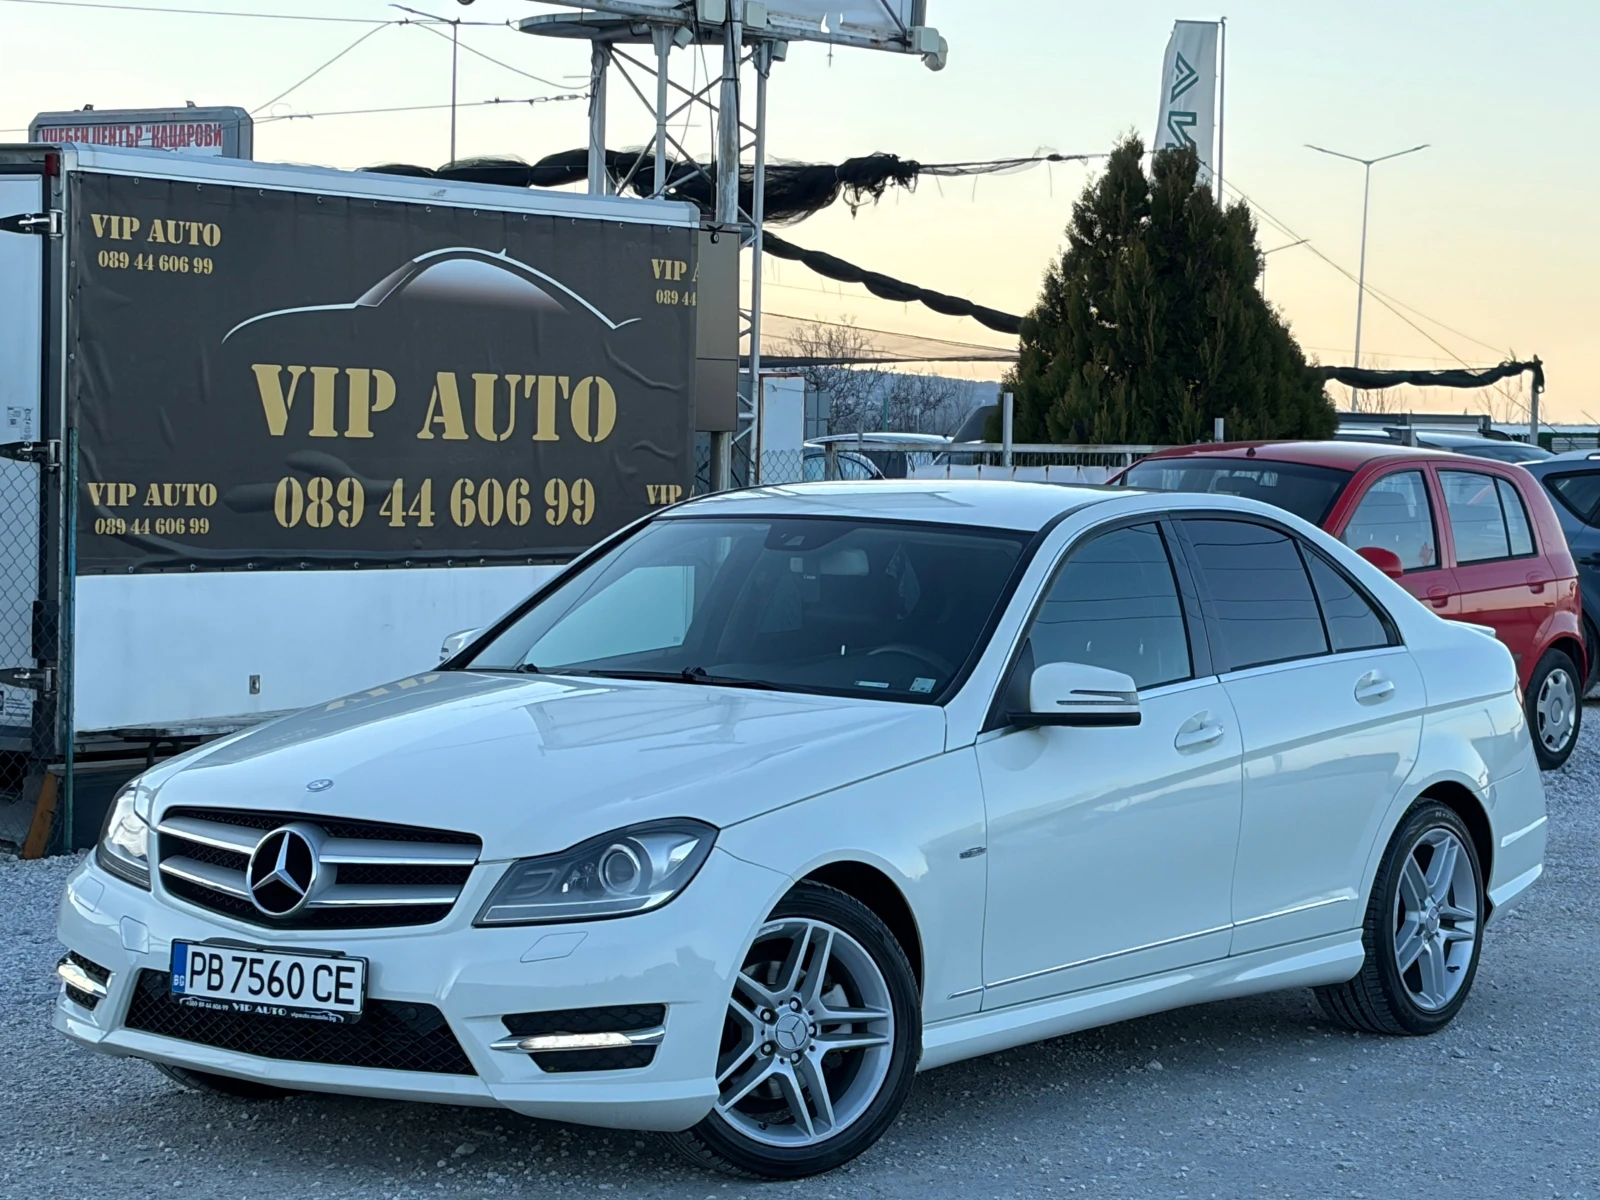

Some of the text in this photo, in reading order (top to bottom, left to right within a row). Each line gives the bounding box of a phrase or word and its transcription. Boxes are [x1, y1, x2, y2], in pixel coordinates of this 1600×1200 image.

[42, 128, 90, 143] УЧЕБЕН
[92, 125, 143, 148] ЦЕНТЪР
[91, 213, 221, 247] VIP AUTO
[98, 250, 213, 275] 089 44 606 99
[651, 258, 687, 281] VIP
[655, 289, 697, 307] 089 44
[251, 363, 617, 443] VIP AUTO
[87, 482, 217, 506] VIP AUTO
[274, 476, 595, 528] 089 44 606 99
[646, 484, 683, 504] VIP
[94, 517, 210, 535] 089 44 606 99
[173, 974, 185, 986] BG
[189, 951, 356, 1005] PB 7560 CE
[232, 1002, 253, 1012] VIP
[255, 1005, 287, 1017] AUTO
